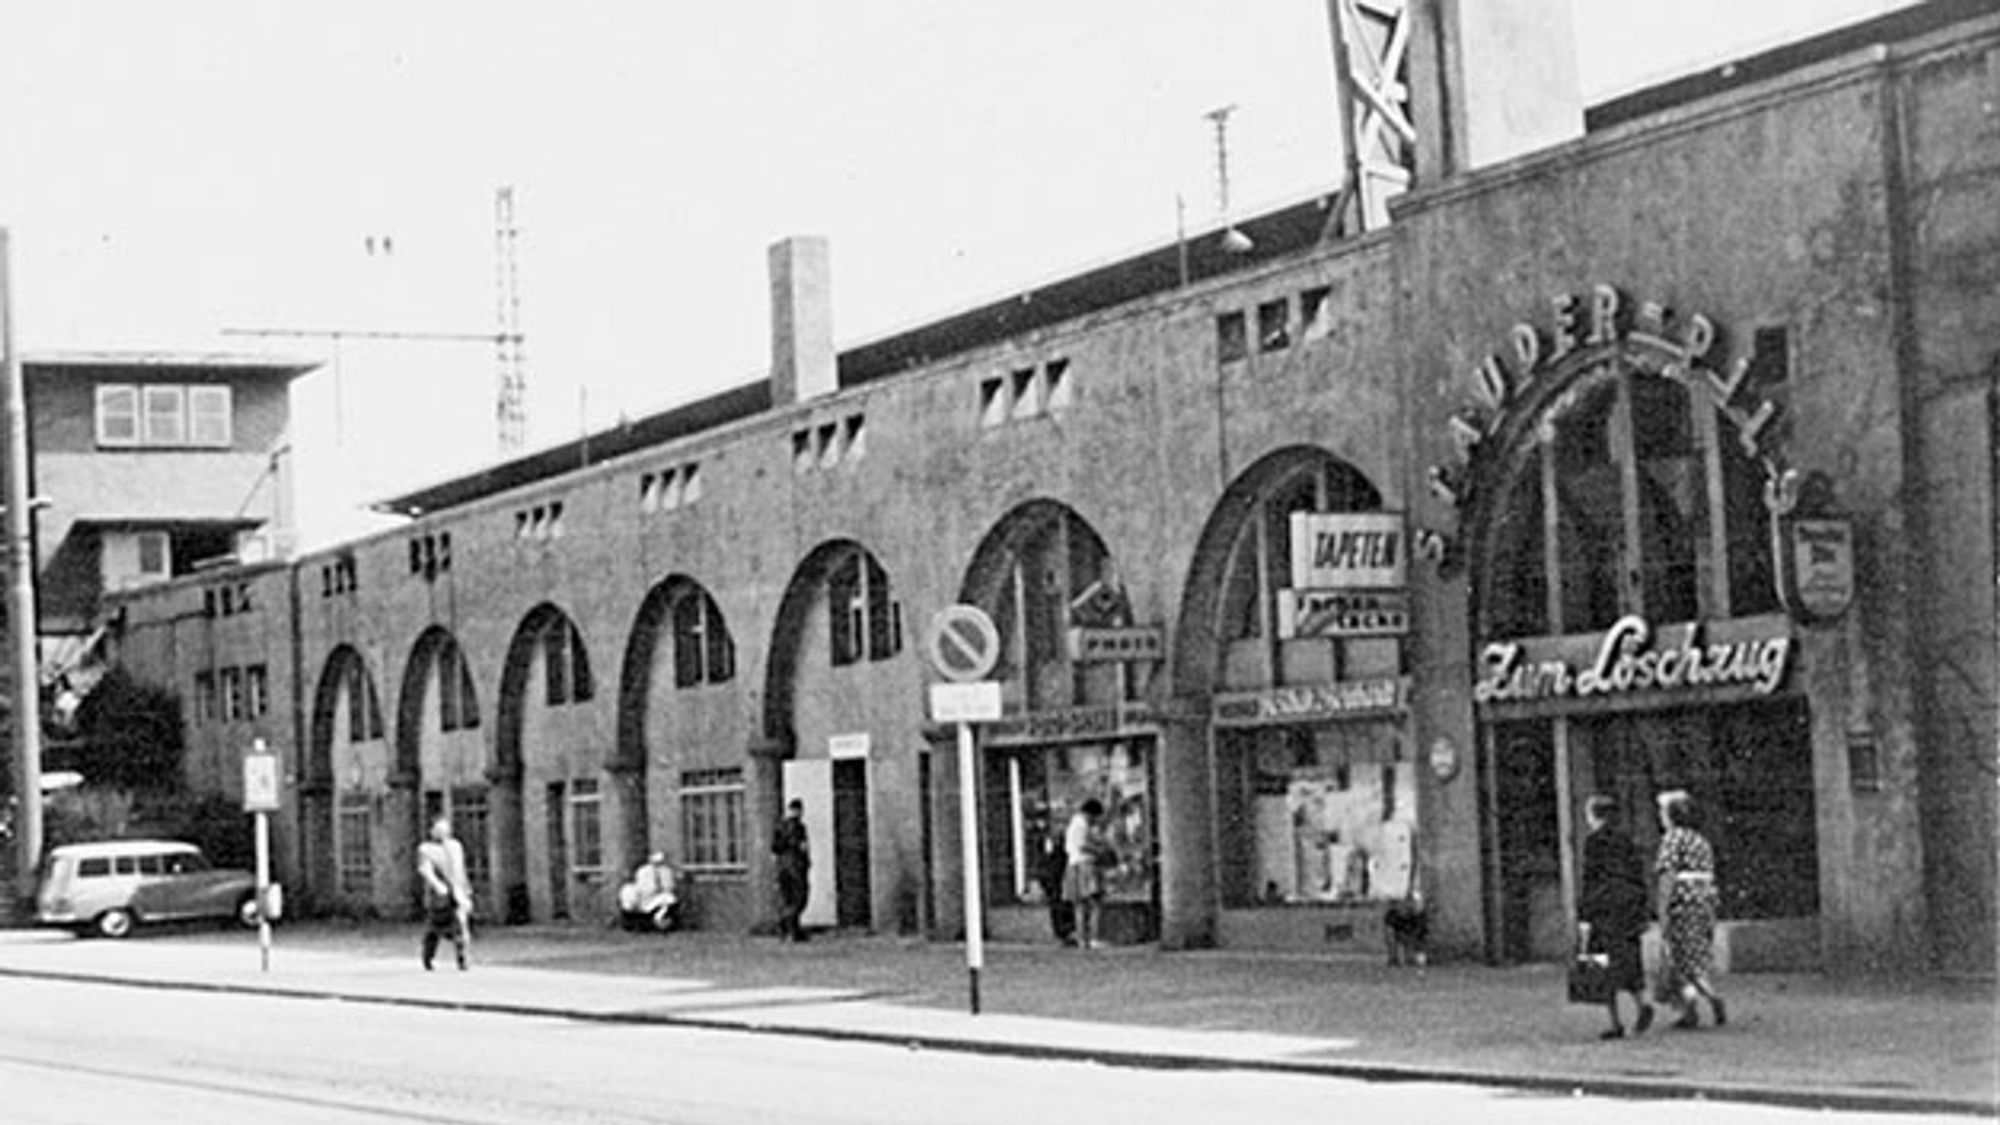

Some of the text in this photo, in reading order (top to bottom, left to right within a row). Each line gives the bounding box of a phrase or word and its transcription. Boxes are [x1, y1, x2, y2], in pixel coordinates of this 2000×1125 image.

[1314, 531, 1400, 569] TAPETEN
[1087, 636, 1156, 652] PHOTO
[1475, 641, 1573, 702] Zum
